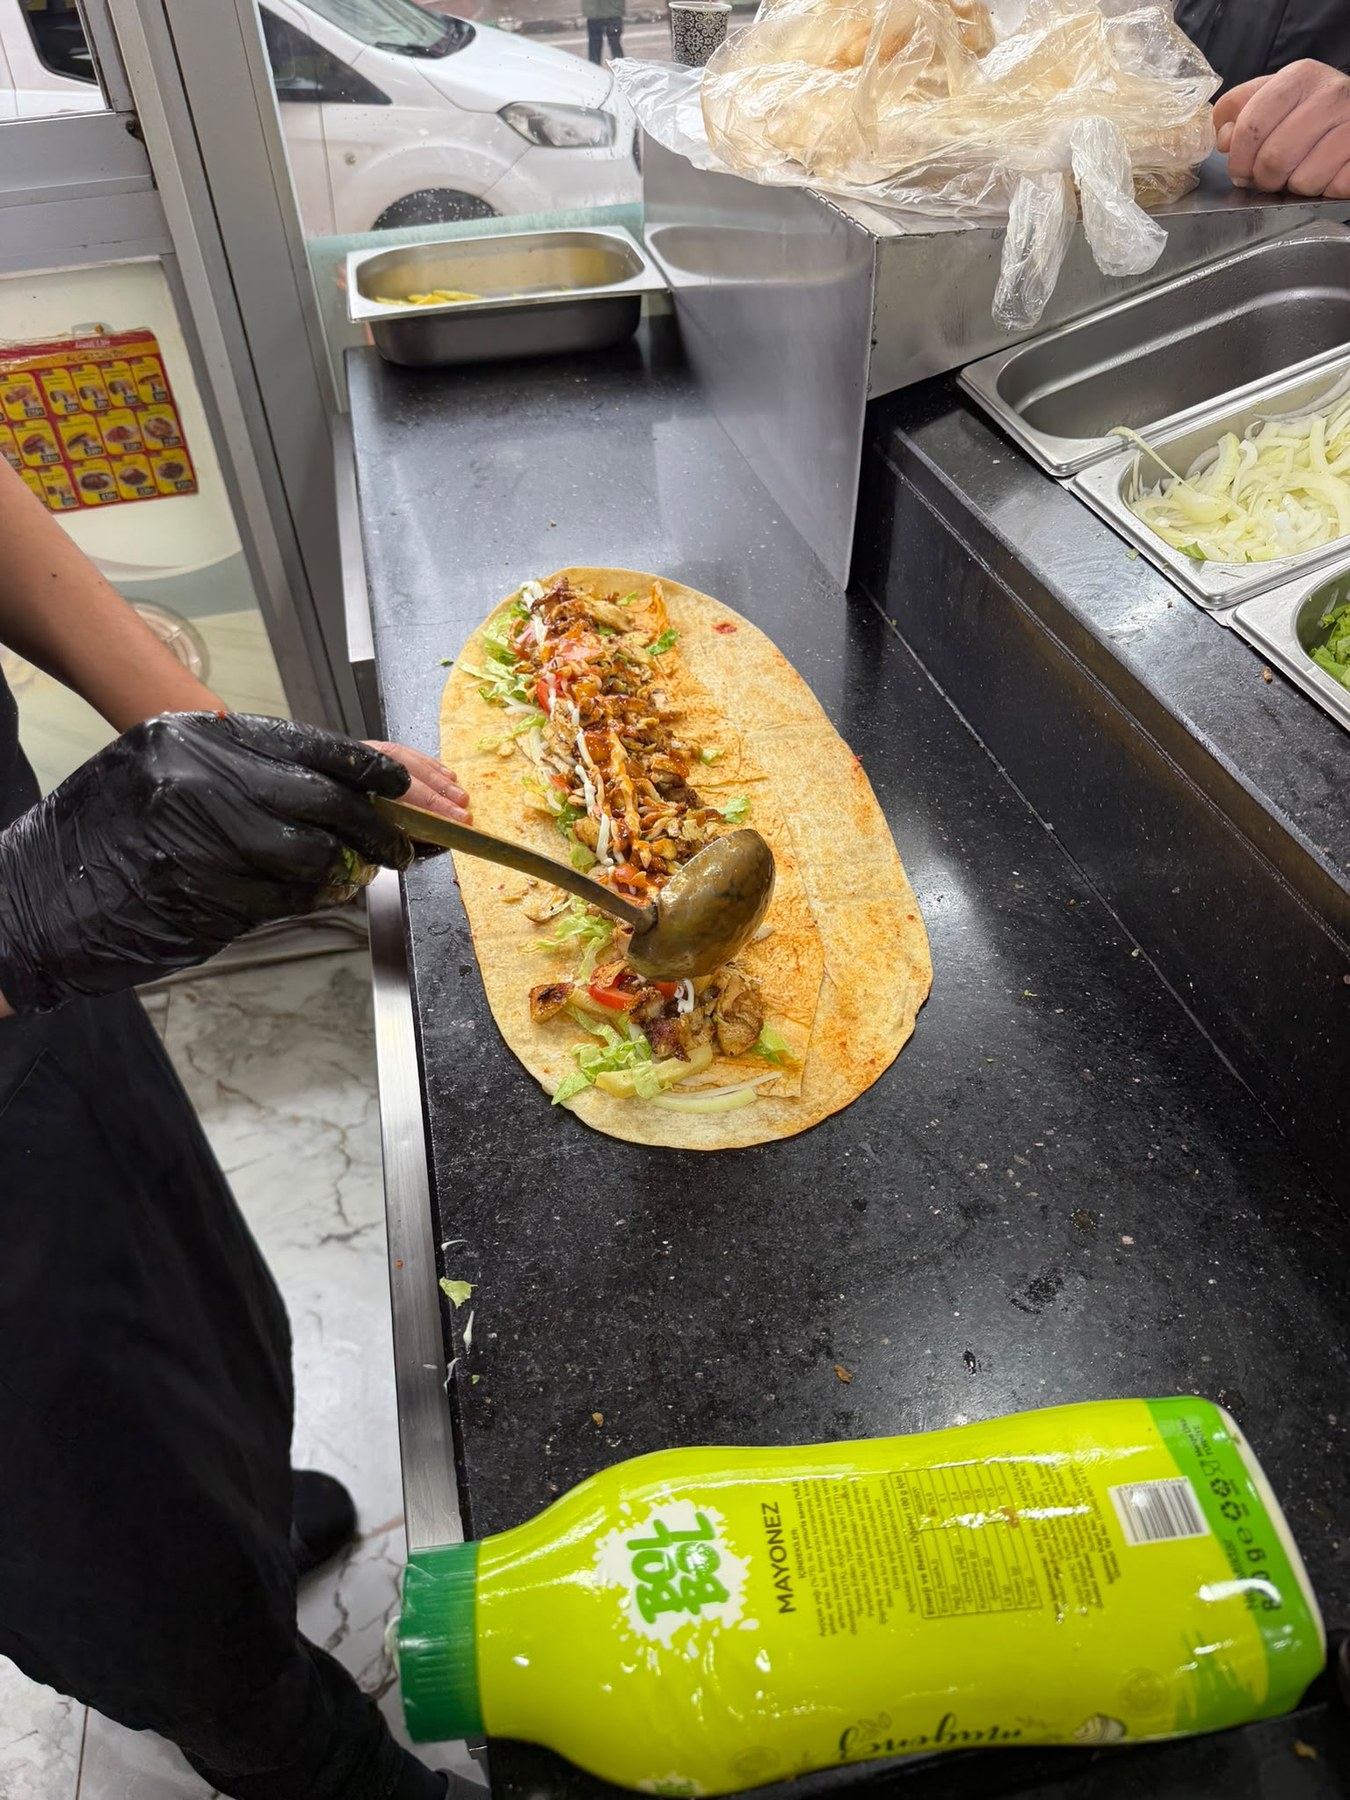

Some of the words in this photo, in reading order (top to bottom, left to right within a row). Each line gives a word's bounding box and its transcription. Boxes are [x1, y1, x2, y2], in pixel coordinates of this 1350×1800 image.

[899, 1496, 911, 1512] 100
[626, 1519, 684, 1624] BOL
[668, 1512, 730, 1615] BOL
[762, 1501, 797, 1613] MAYONEZ
[911, 1545, 927, 1571] Besin
[920, 1574, 930, 1585] ve
[921, 1587, 938, 1616] Enerji
